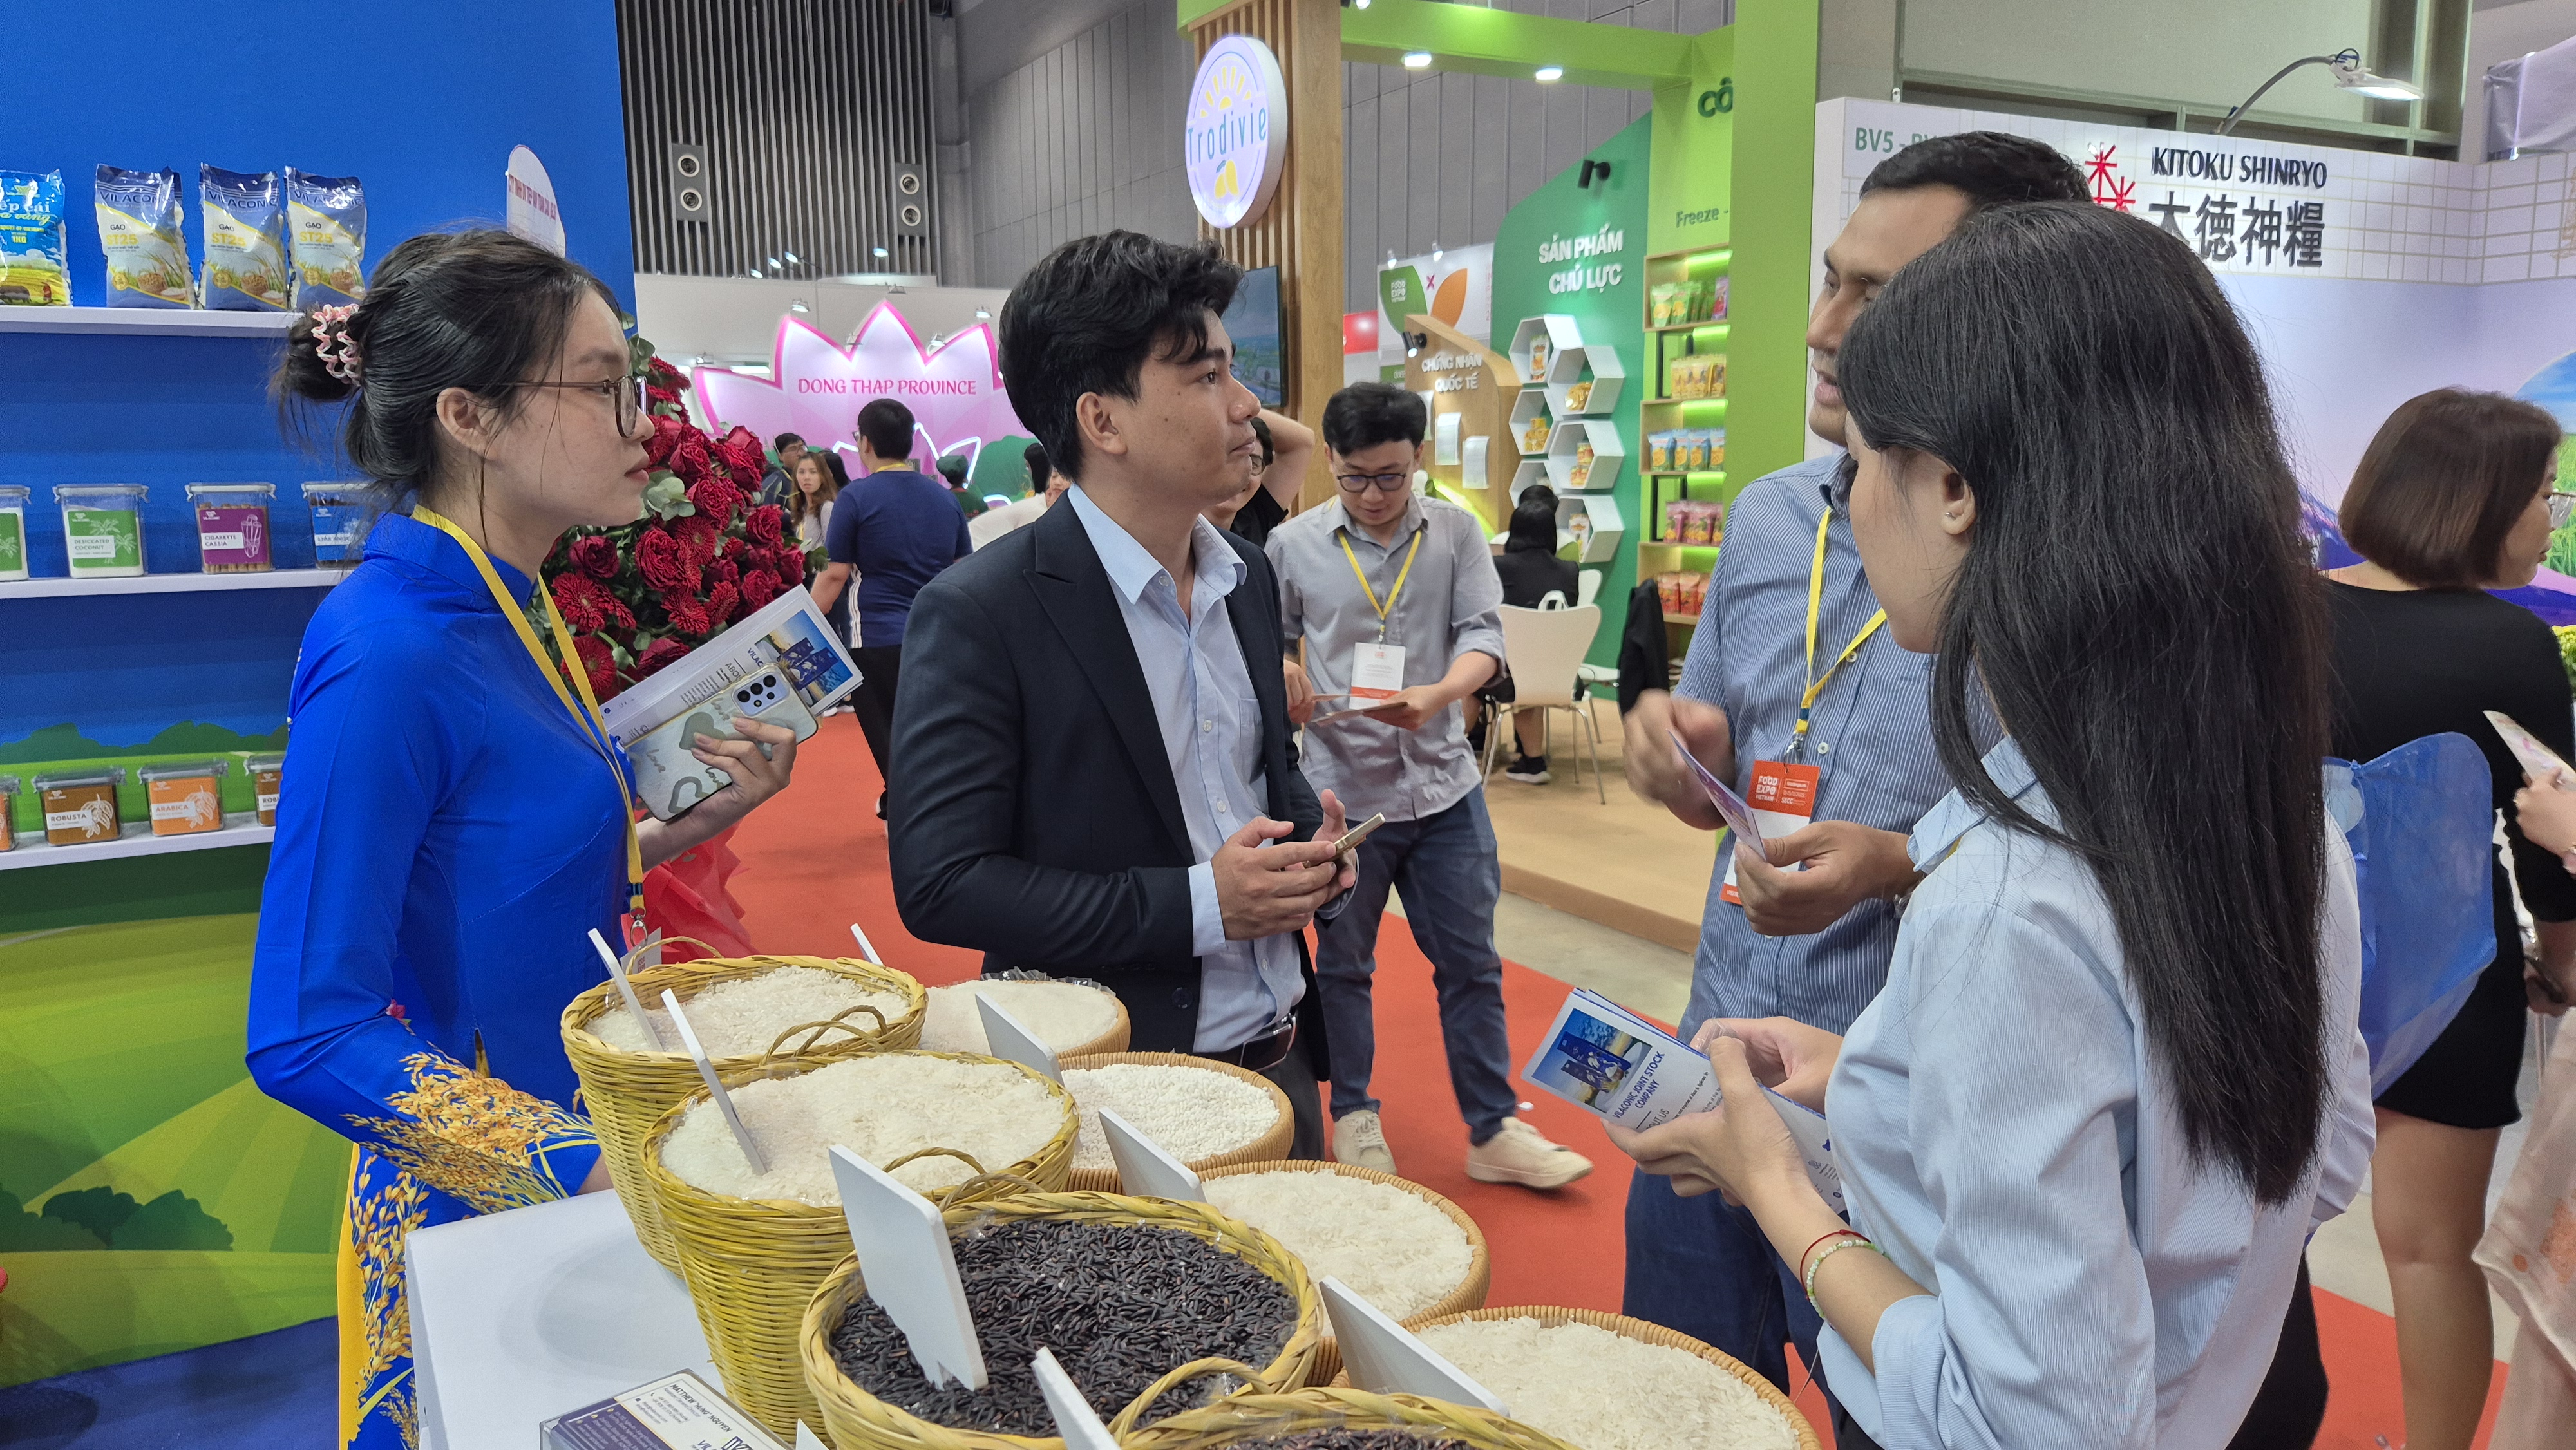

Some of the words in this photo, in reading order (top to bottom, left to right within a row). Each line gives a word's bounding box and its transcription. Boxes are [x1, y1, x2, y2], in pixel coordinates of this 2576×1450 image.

[1188, 103, 1266, 165] Trodivie
[1855, 127, 1893, 153] BV5
[2151, 147, 2234, 181] KITOKU
[2239, 155, 2327, 189] SHINRYO
[1676, 208, 1719, 228] Freeze
[106, 234, 139, 245] ST25
[212, 232, 247, 247] ST25
[299, 232, 334, 243] ST25
[798, 379, 847, 395] DONG
[851, 379, 894, 395] THAP
[898, 379, 977, 395] PROVINCE
[748, 648, 764, 667] VILAC
[1758, 775, 1779, 786] FOOD
[1756, 784, 1776, 795] EXPO
[51, 813, 87, 822] ROBUSTA
[1613, 1091, 1638, 1118] VILACONIC
[1633, 1075, 1649, 1094] JOINT
[1644, 1051, 1665, 1077] STOCK
[1634, 1079, 1660, 1109] COMPANY
[1657, 1108, 1669, 1118] US
[670, 1384, 697, 1404] MATTHEW
[709, 1414, 732, 1433] NGUYEN
